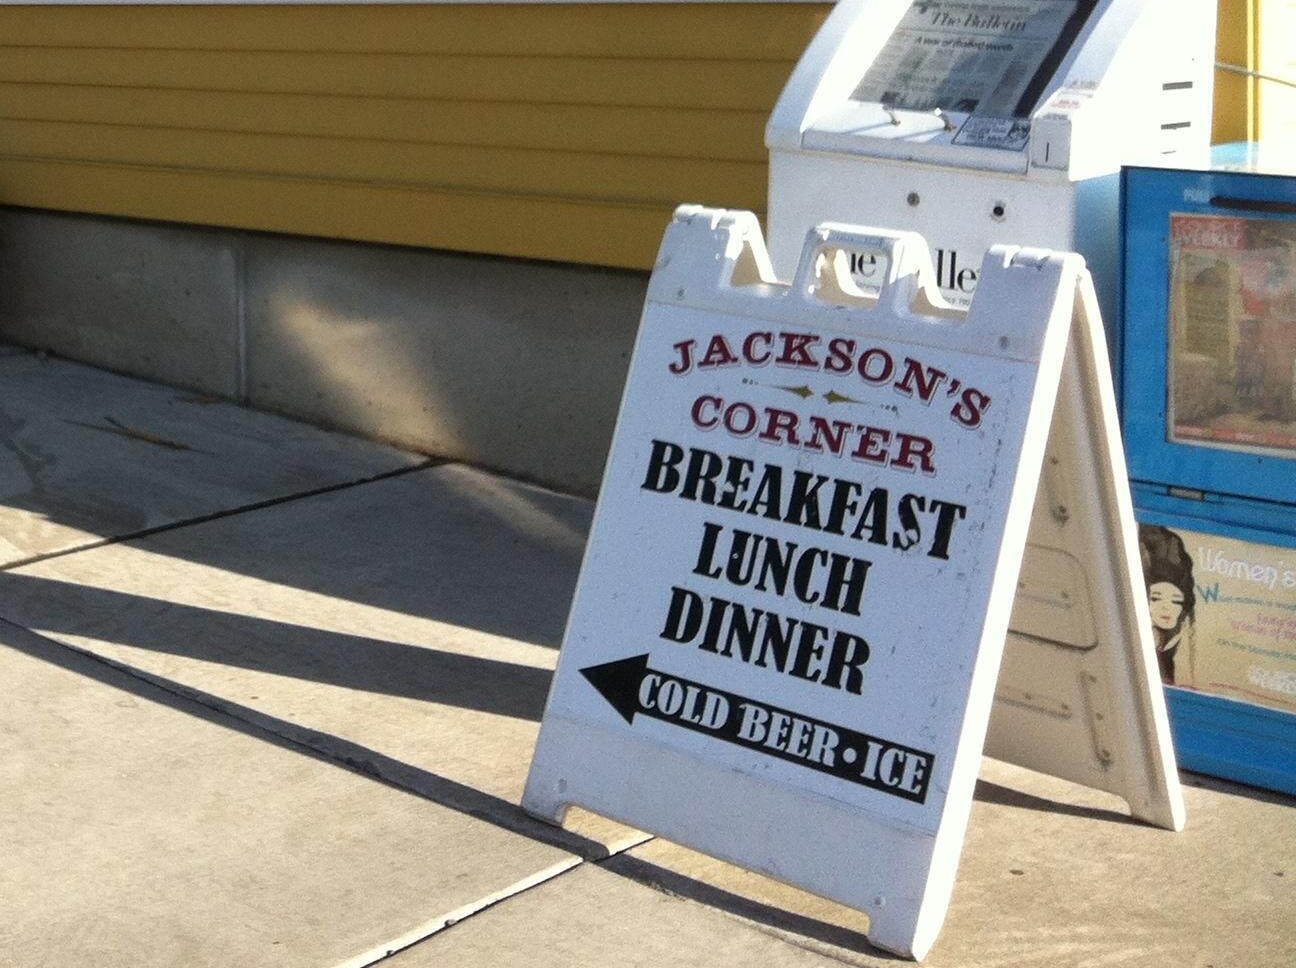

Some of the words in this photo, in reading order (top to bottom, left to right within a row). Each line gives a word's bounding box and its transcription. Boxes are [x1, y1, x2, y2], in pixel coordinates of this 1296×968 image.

[668, 331, 991, 430] JACKSON'S
[690, 395, 937, 475] CORNER
[641, 438, 967, 561] BREAKFAST
[692, 521, 873, 617] LUNCH
[659, 585, 872, 696] DINNER
[637, 672, 729, 731] COLD
